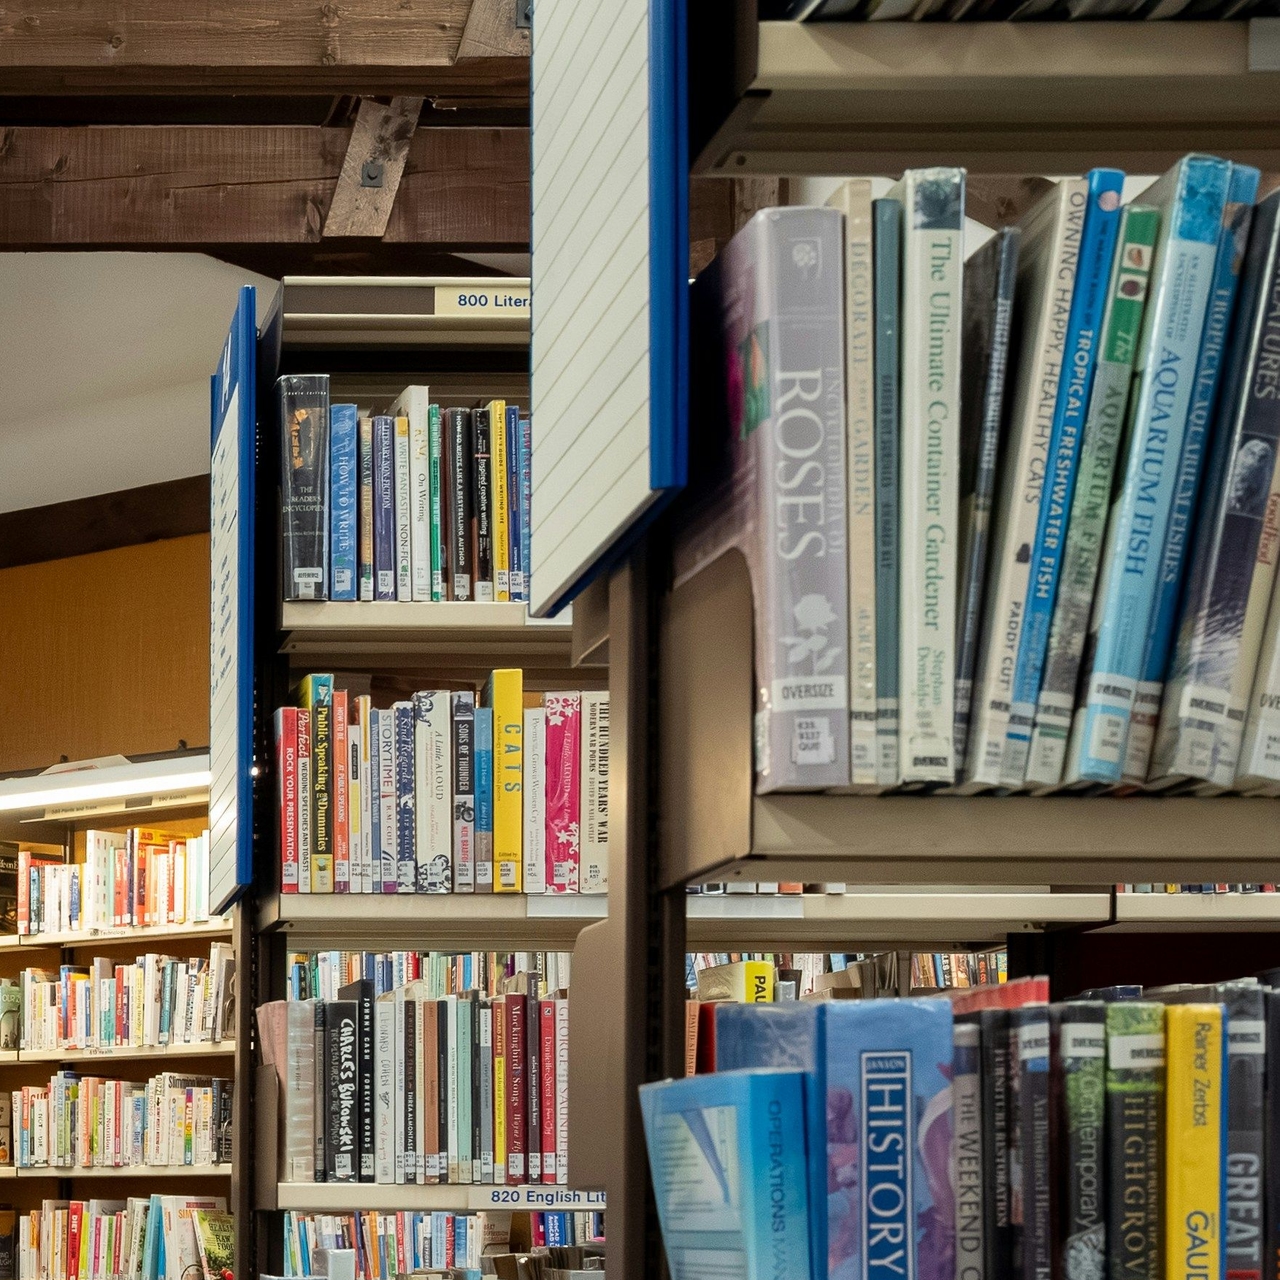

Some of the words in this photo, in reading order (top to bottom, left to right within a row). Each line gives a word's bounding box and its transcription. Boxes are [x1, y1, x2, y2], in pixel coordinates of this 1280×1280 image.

[931, 235, 952, 282] The
[458, 295, 488, 306] 800
[929, 286, 951, 393] Ultimate
[1134, 347, 1181, 499] AQUARIUM
[774, 367, 827, 560] ROSES
[926, 400, 948, 516] Container
[1123, 503, 1155, 579] FISH
[923, 522, 946, 631] Gardener
[459, 723, 469, 743] SONS
[459, 745, 469, 754] OF
[504, 724, 521, 793] CATS
[459, 757, 469, 791] THUNDER
[340, 1018, 355, 1080] CHARLES
[339, 1083, 355, 1151] BUKOWSKI
[491, 1191, 520, 1202] 820
[527, 1191, 580, 1205] English
[867, 1080, 905, 1274] HISTORY
[1225, 1152, 1260, 1262] GREAT
